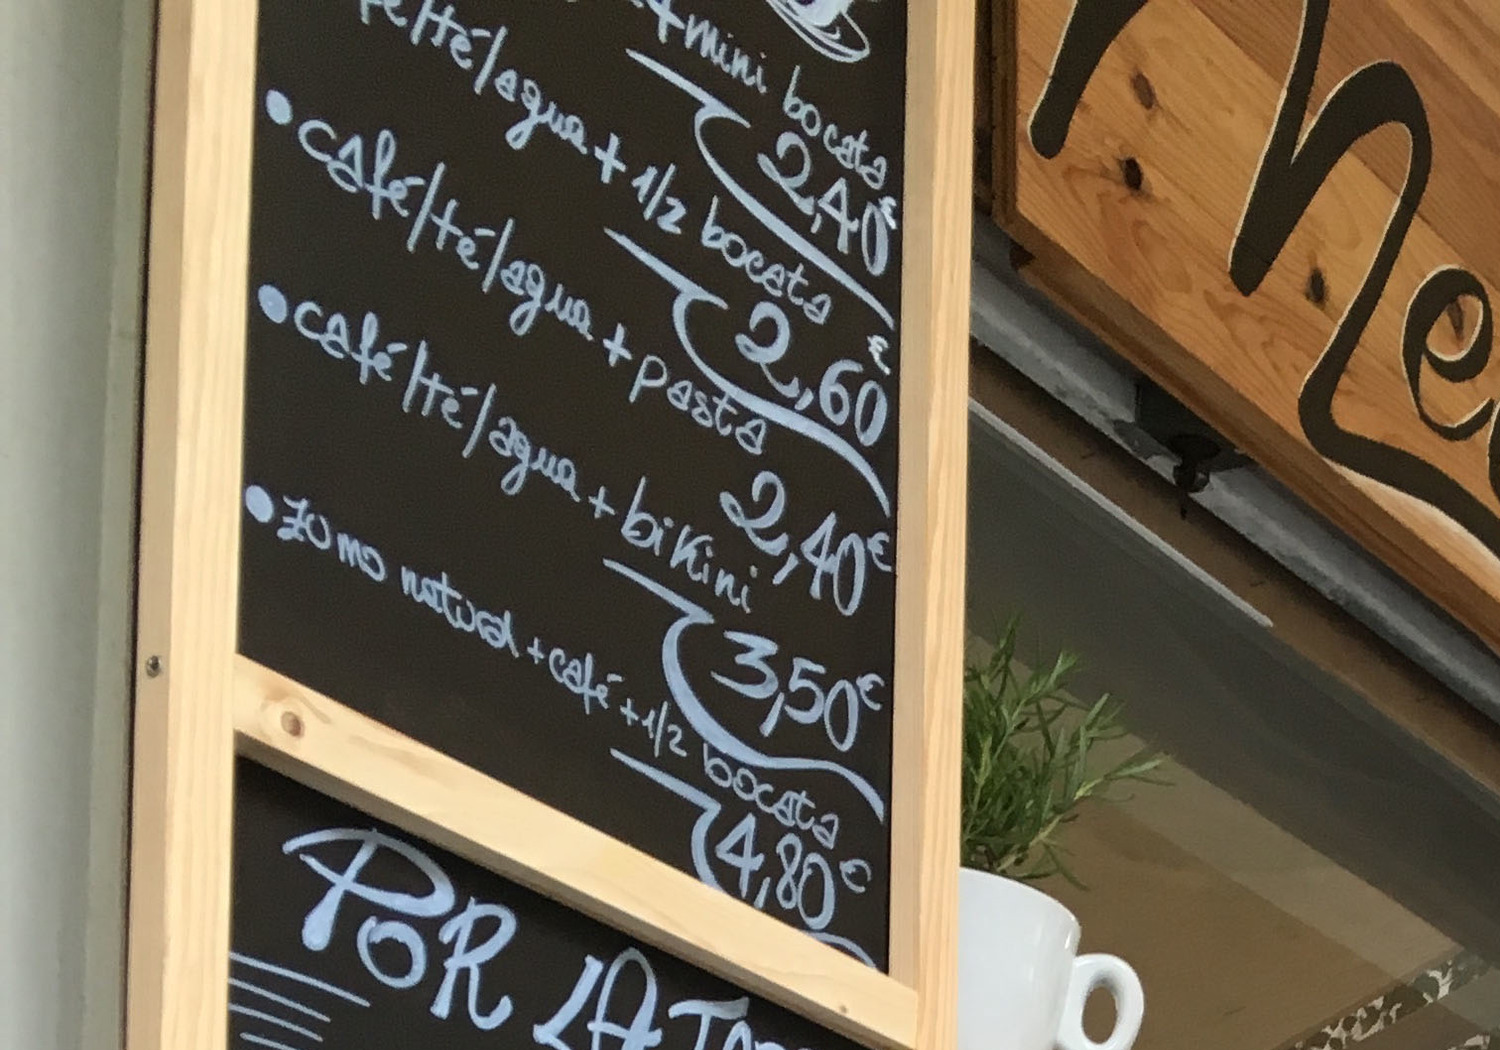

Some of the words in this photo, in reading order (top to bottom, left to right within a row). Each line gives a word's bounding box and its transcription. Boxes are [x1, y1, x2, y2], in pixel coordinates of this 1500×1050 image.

[701, 195, 832, 326] bocata
[628, 356, 767, 455] pasta
[282, 827, 518, 1030] POR
